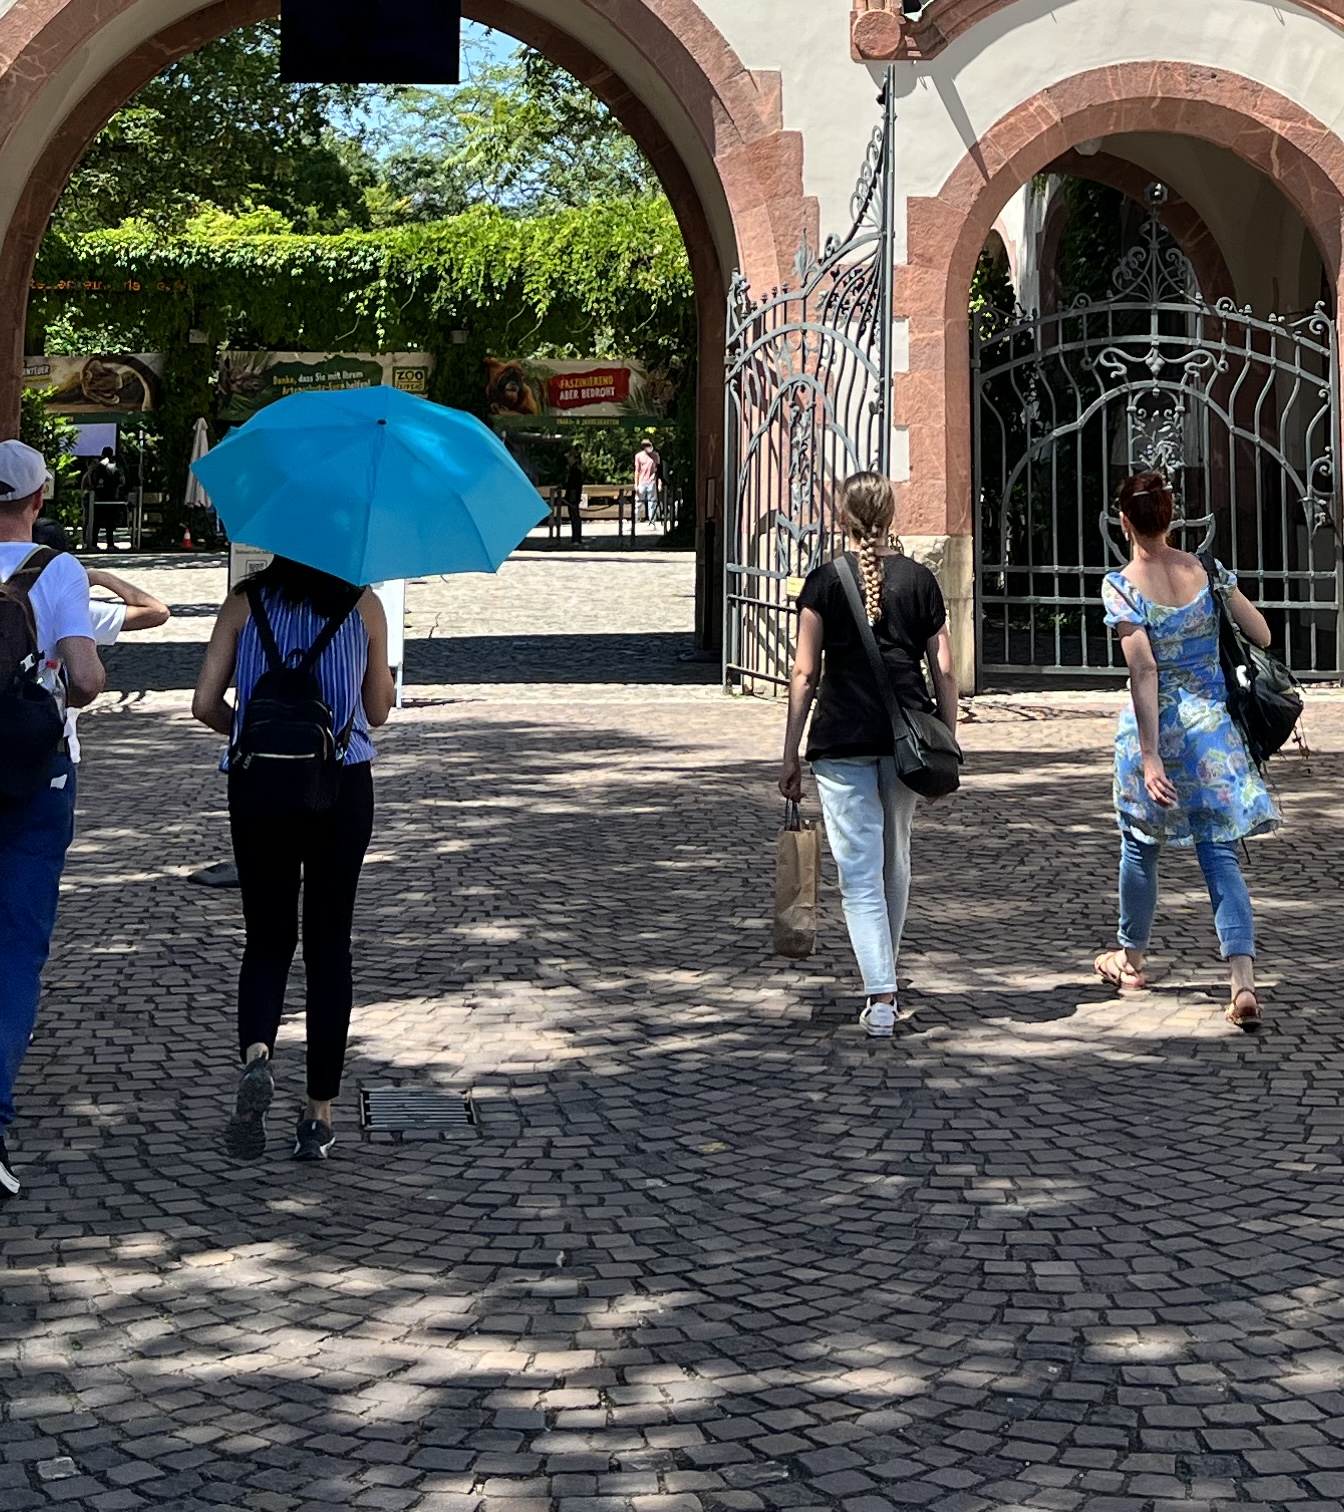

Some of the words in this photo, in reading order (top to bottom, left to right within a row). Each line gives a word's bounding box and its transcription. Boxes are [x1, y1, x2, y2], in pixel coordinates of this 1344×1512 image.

[298, 373, 314, 383] dass
[315, 372, 326, 381] Sie
[327, 371, 342, 381] mit
[342, 370, 364, 379] Ihrem
[396, 370, 423, 381] ZOO
[560, 376, 613, 388] FASZINIEREND
[560, 390, 579, 400] ABER
[581, 387, 615, 398] BEDROHT
